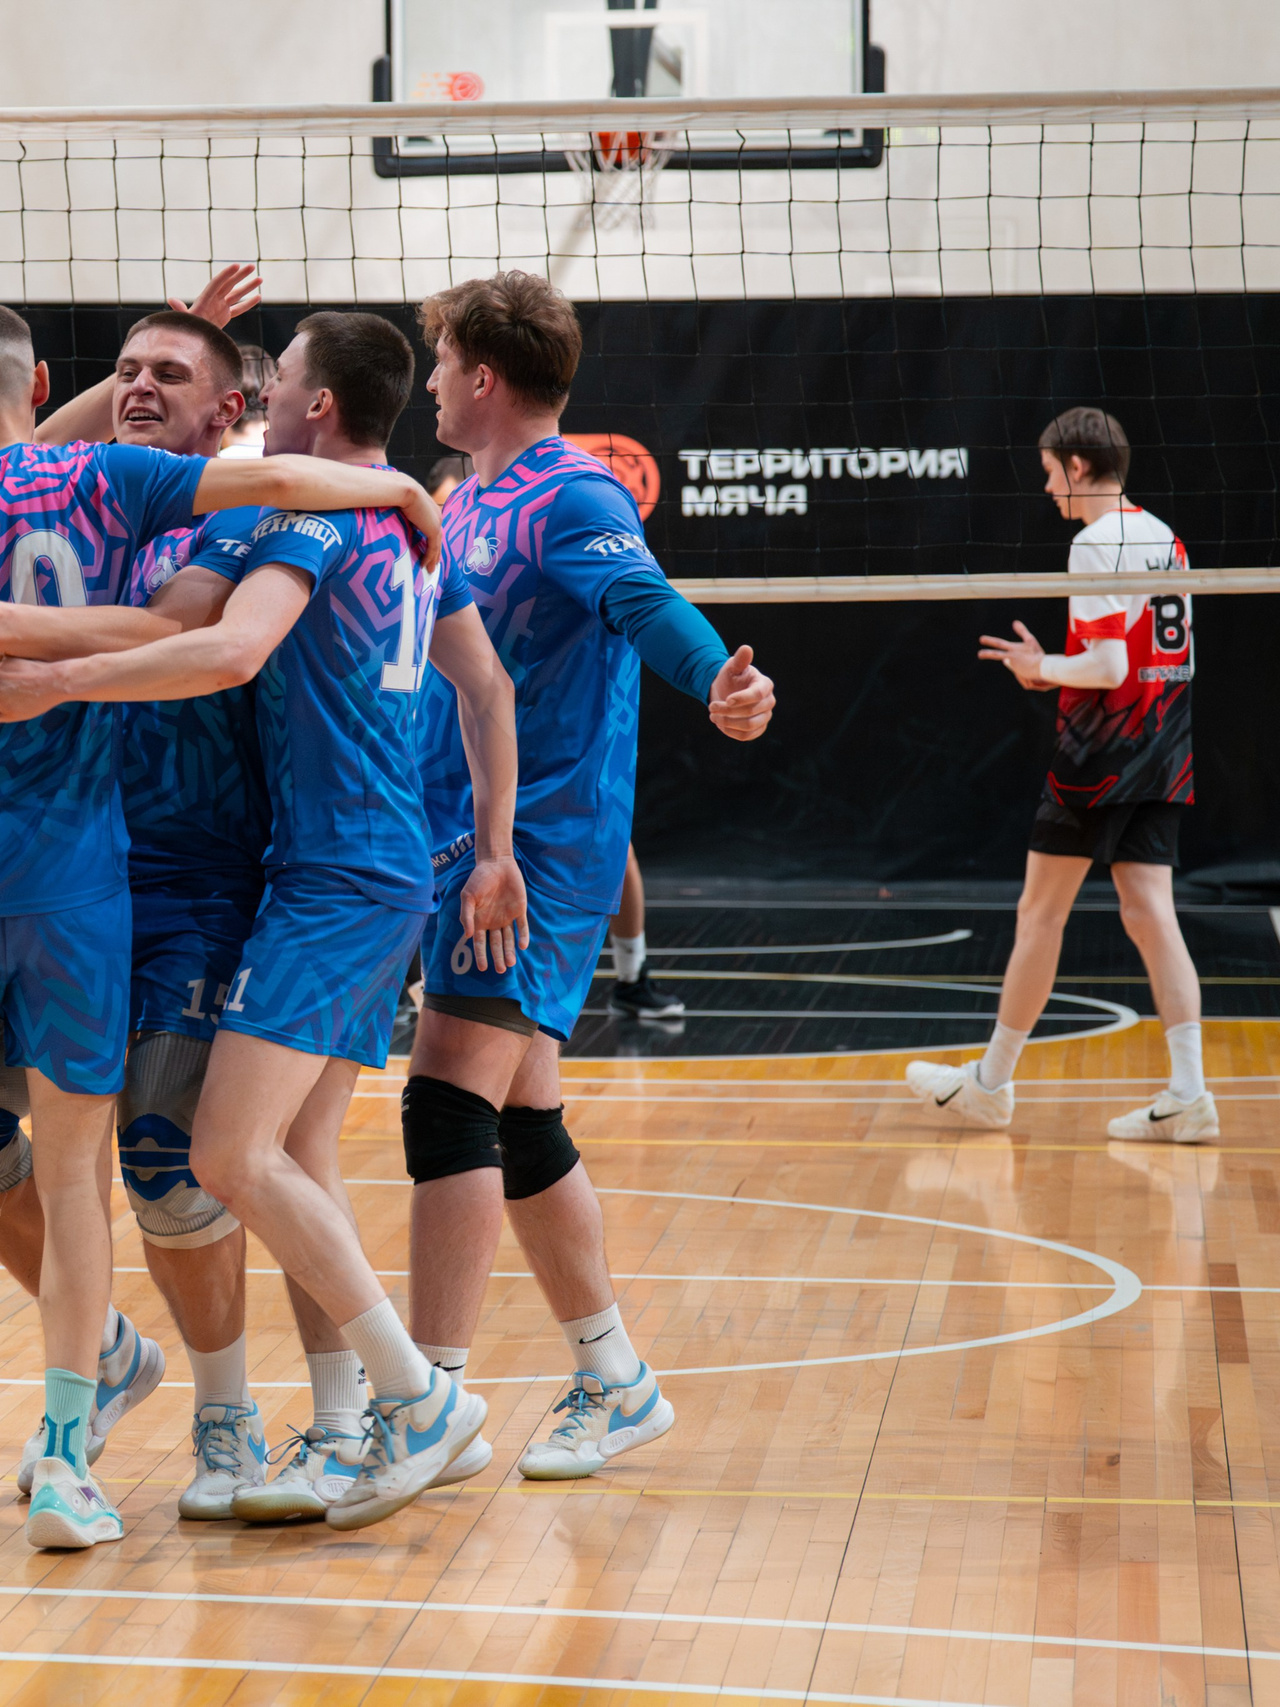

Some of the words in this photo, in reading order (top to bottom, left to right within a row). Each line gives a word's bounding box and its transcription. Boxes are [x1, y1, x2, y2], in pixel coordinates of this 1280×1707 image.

[678, 448, 968, 480] ТЕРРИТОРИЯ
[681, 485, 808, 517] МЯЧА
[223, 967, 253, 1012] 1
